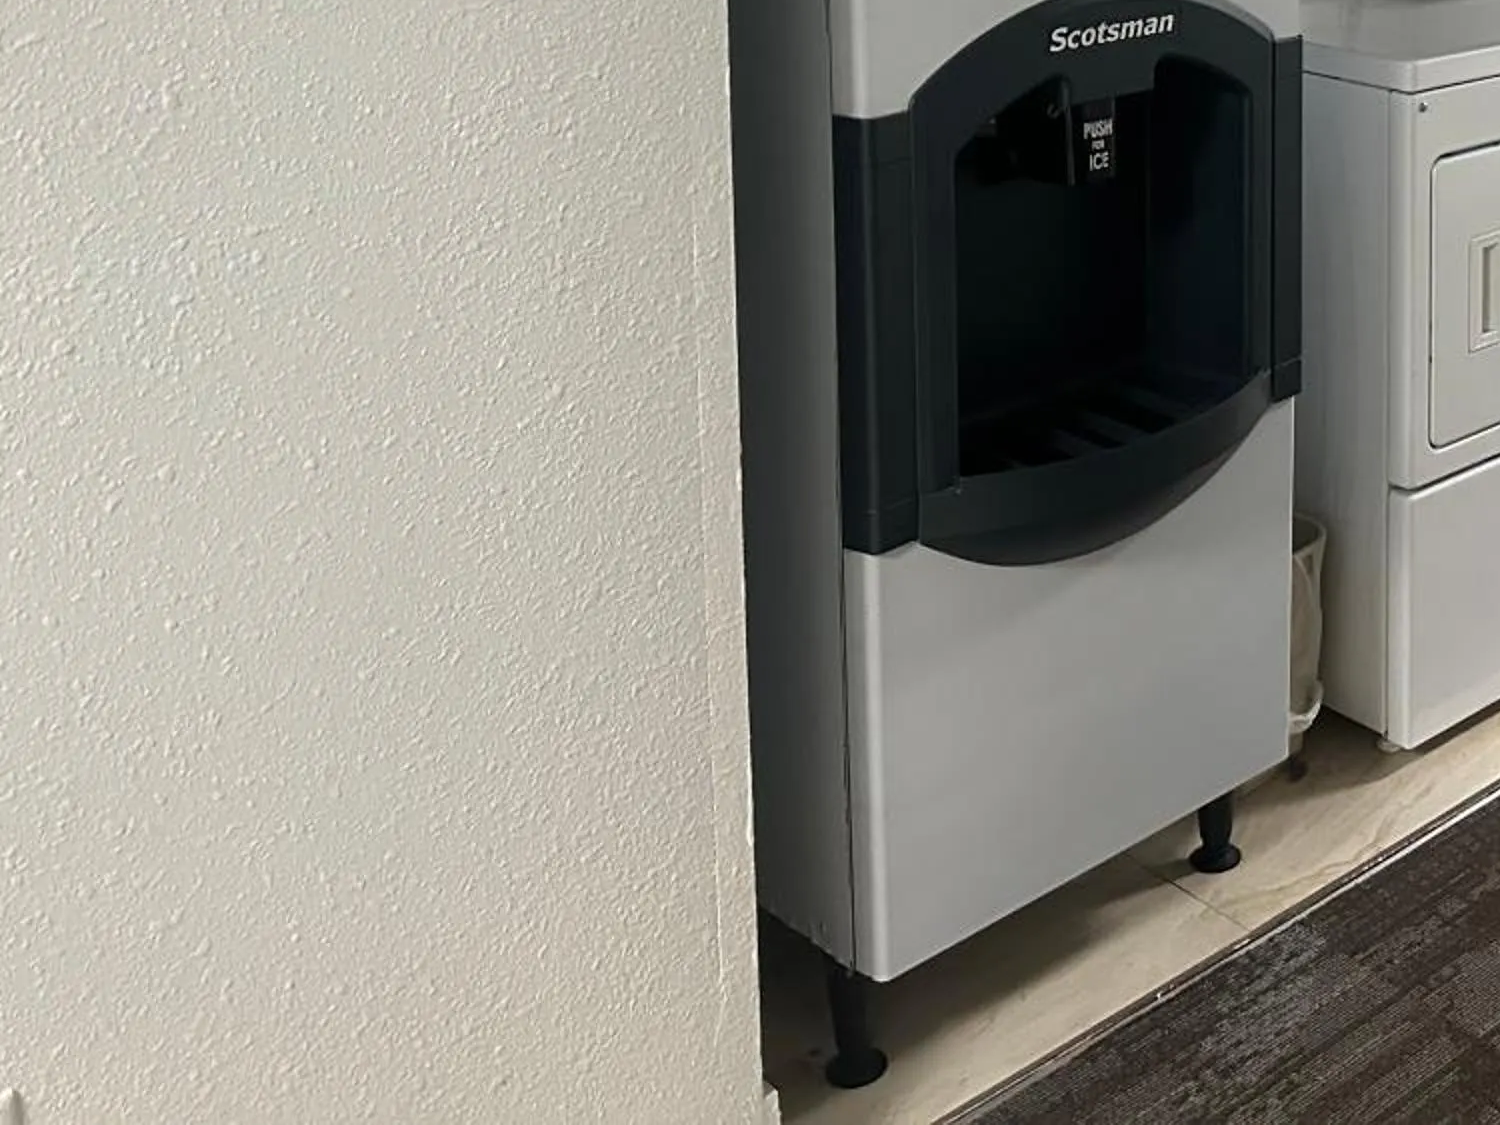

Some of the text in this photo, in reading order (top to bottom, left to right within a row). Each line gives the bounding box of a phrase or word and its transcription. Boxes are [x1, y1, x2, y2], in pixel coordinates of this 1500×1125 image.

[1050, 14, 1175, 52] Scotsman
[1083, 118, 1113, 140] PUSH
[1089, 152, 1110, 171] ICE
